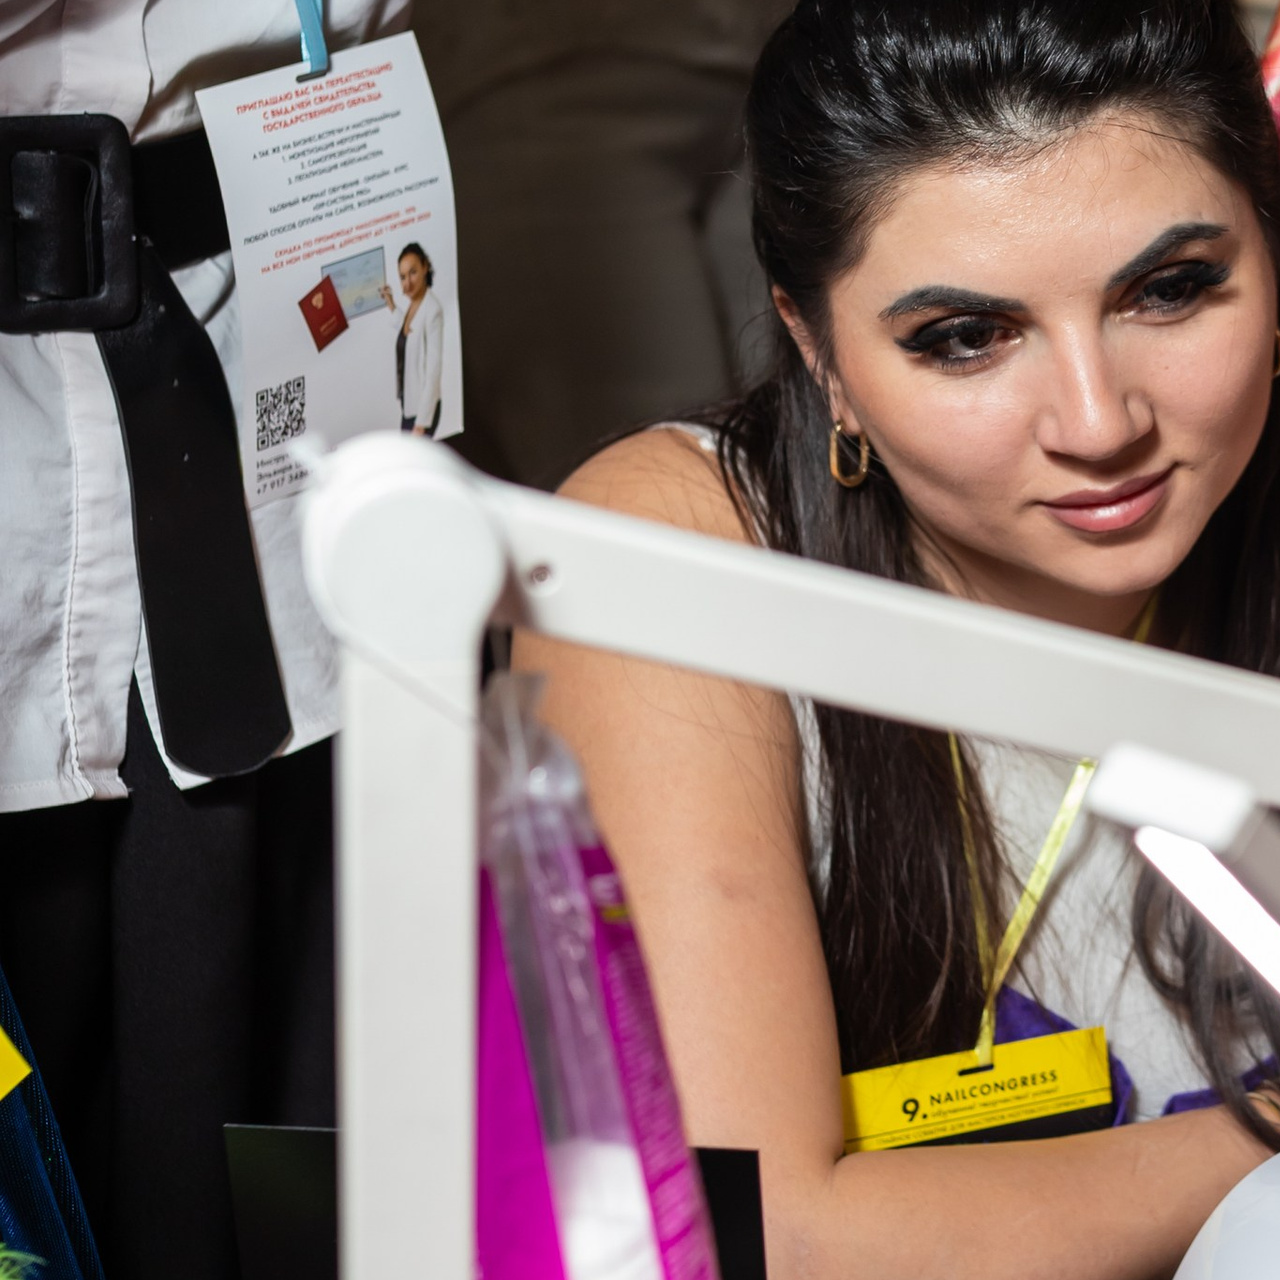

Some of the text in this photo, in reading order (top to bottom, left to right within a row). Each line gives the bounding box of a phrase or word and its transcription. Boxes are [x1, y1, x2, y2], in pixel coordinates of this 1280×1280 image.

[295, 87, 309, 99] ВАС
[313, 83, 323, 93] НА
[901, 1098, 928, 1122] 9.
[930, 1070, 1057, 1106] NAILCONGRESS
